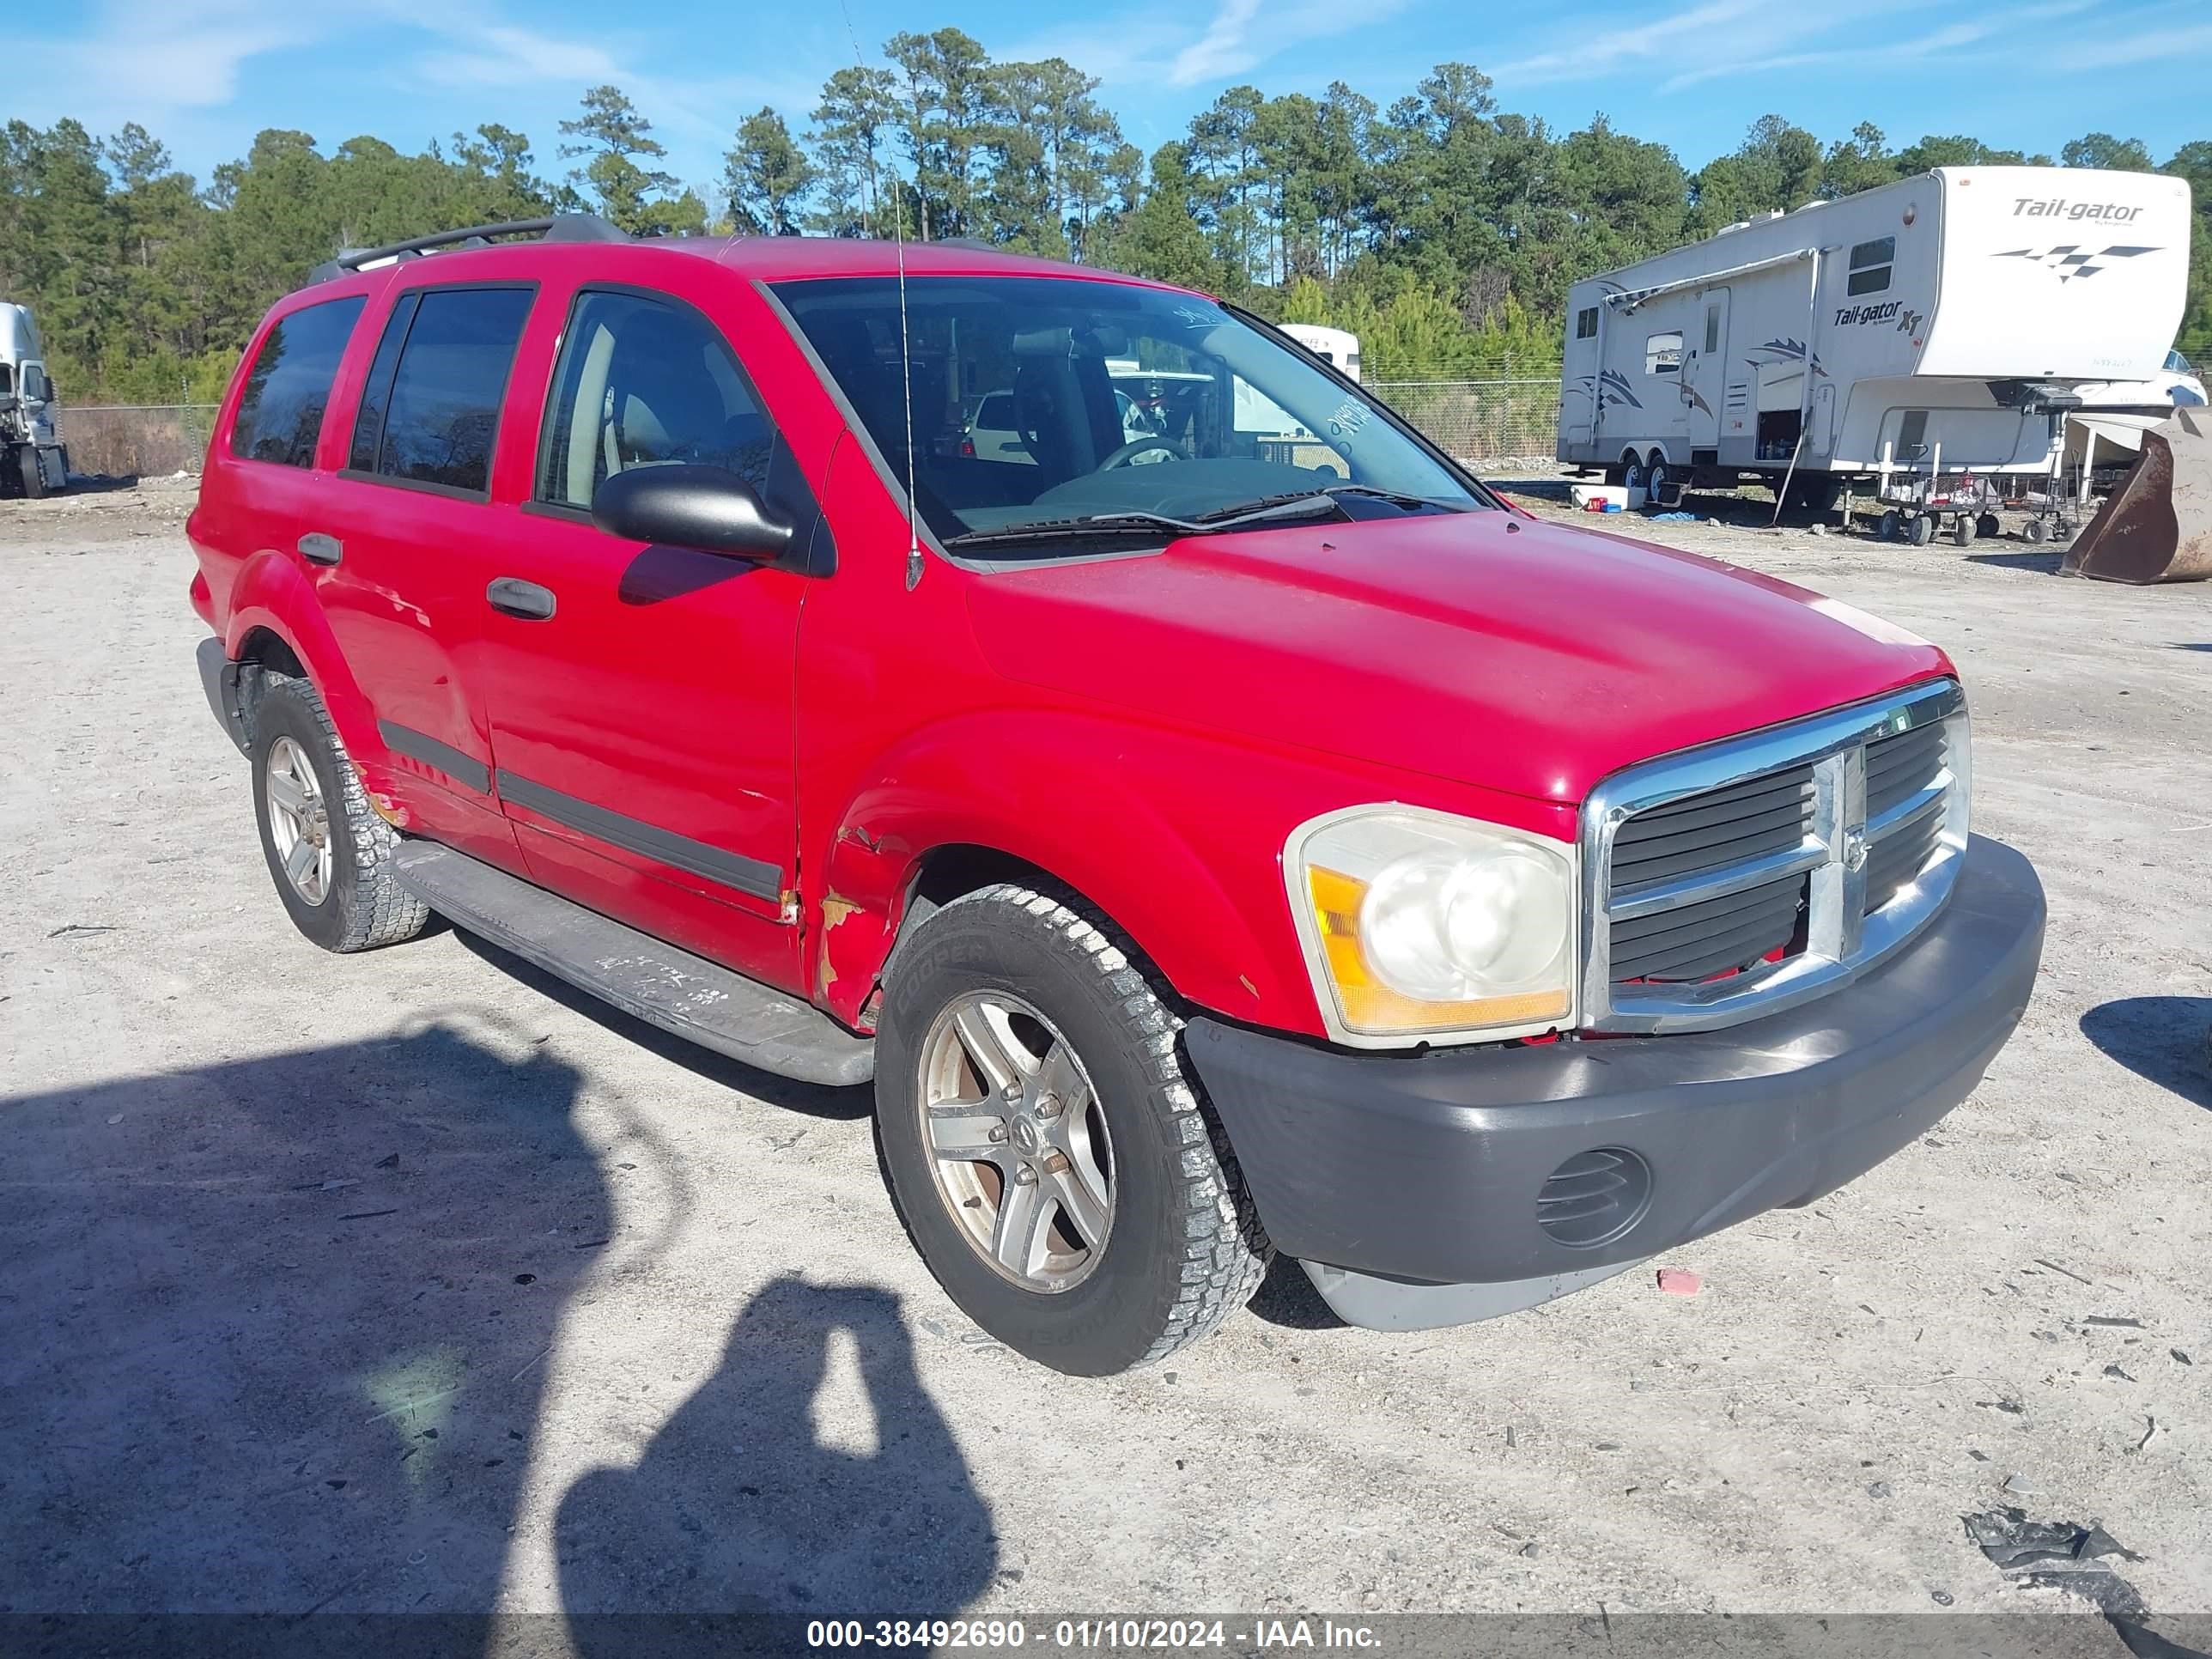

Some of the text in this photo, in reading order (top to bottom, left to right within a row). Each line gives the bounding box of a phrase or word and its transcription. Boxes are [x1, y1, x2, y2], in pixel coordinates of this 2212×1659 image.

[2013, 198, 2144, 222] Tail-gator
[1834, 301, 1923, 337] Tail-gator XT
